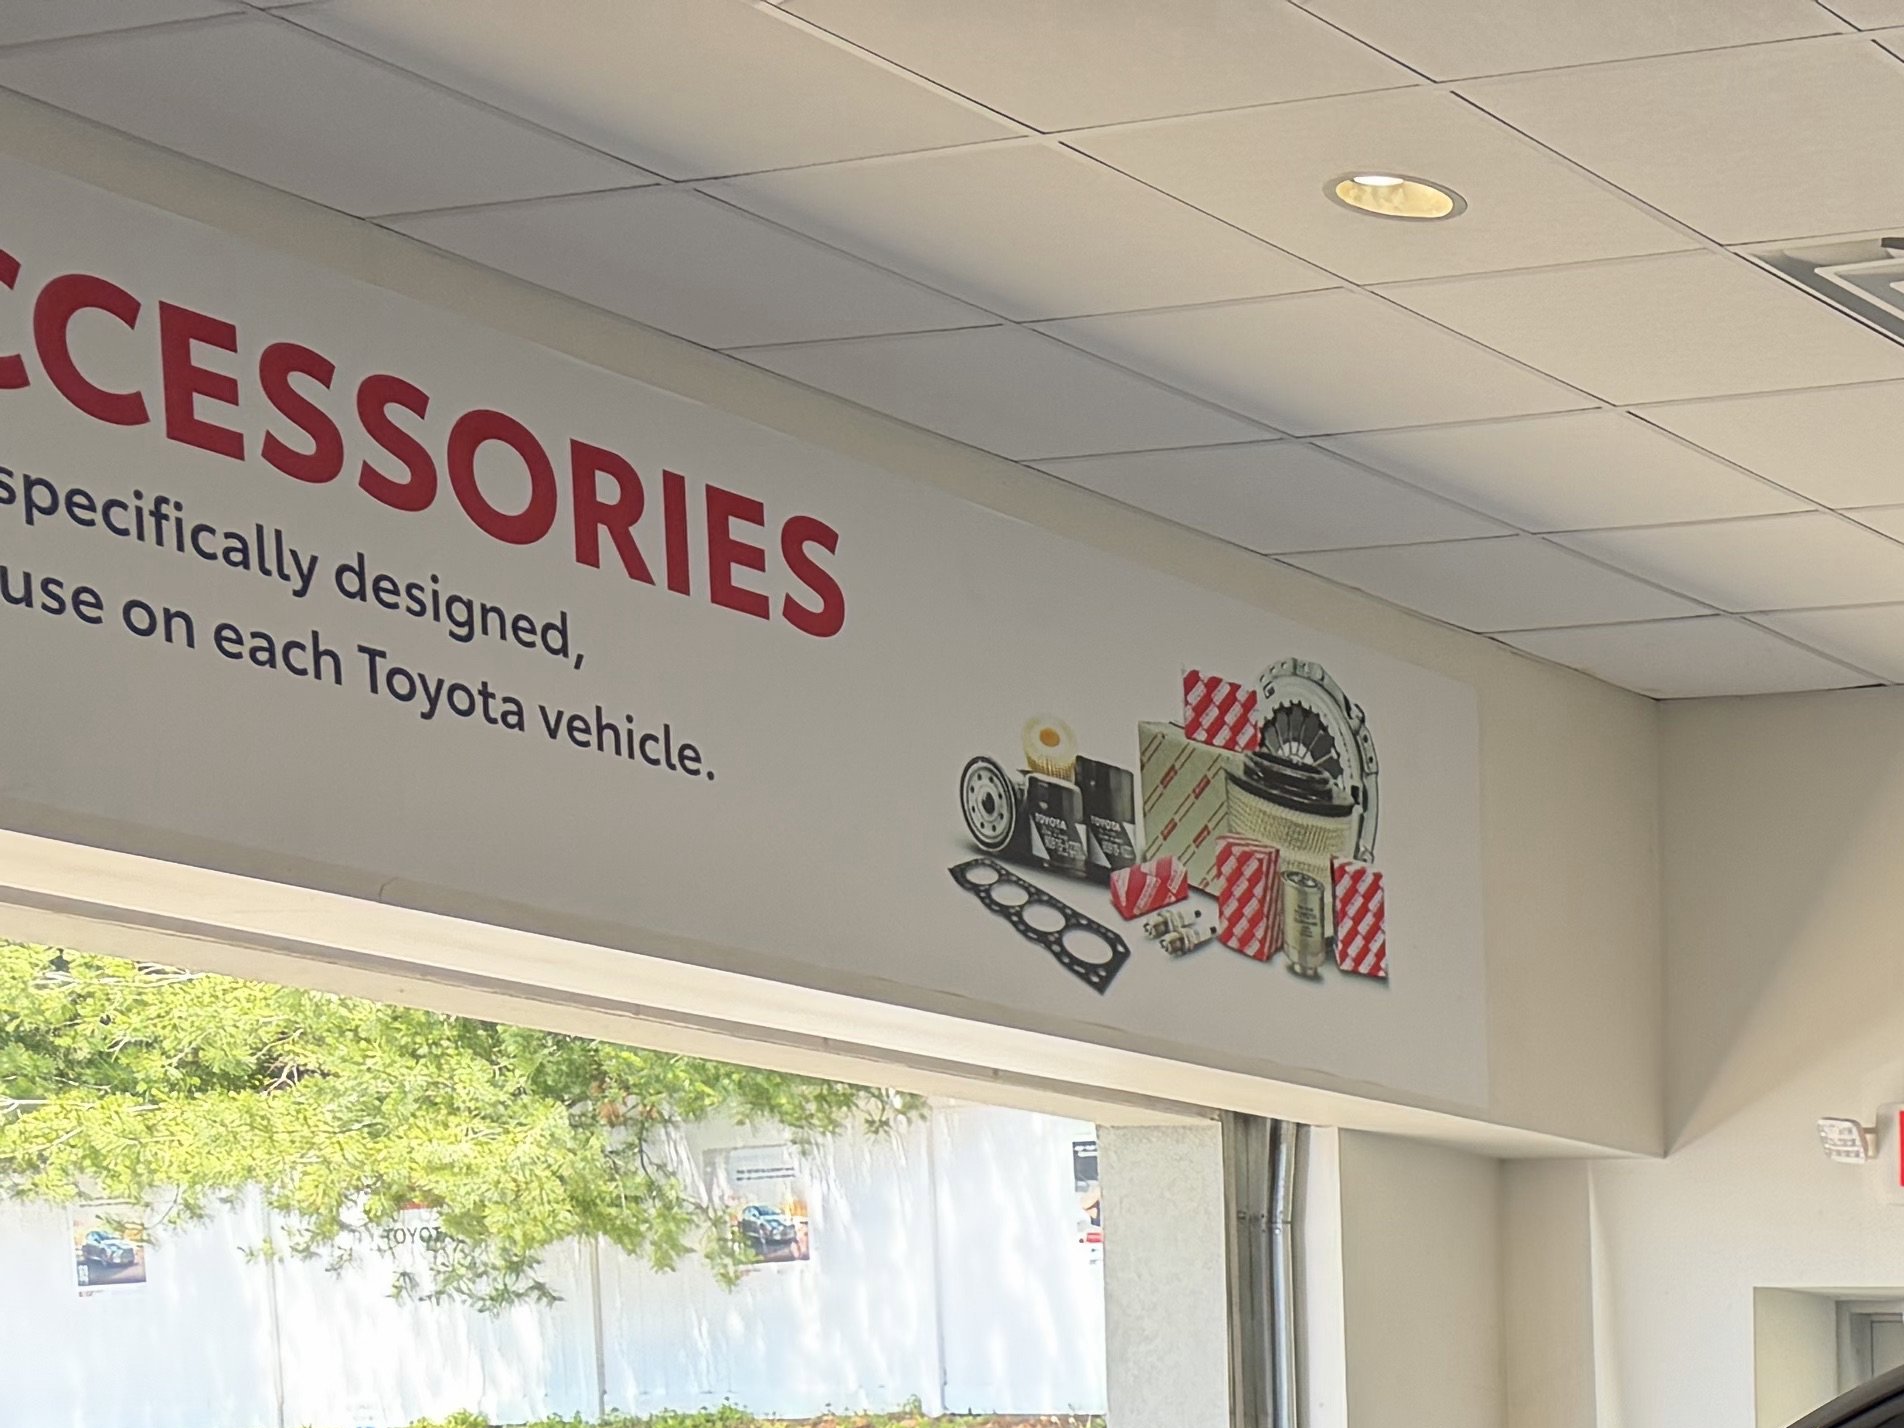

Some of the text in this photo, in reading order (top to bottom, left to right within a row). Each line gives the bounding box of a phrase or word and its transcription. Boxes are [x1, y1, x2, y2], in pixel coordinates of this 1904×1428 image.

[0, 465, 586, 670] specifically designed,
[0, 564, 718, 782] use on each Toyota vehicle.
